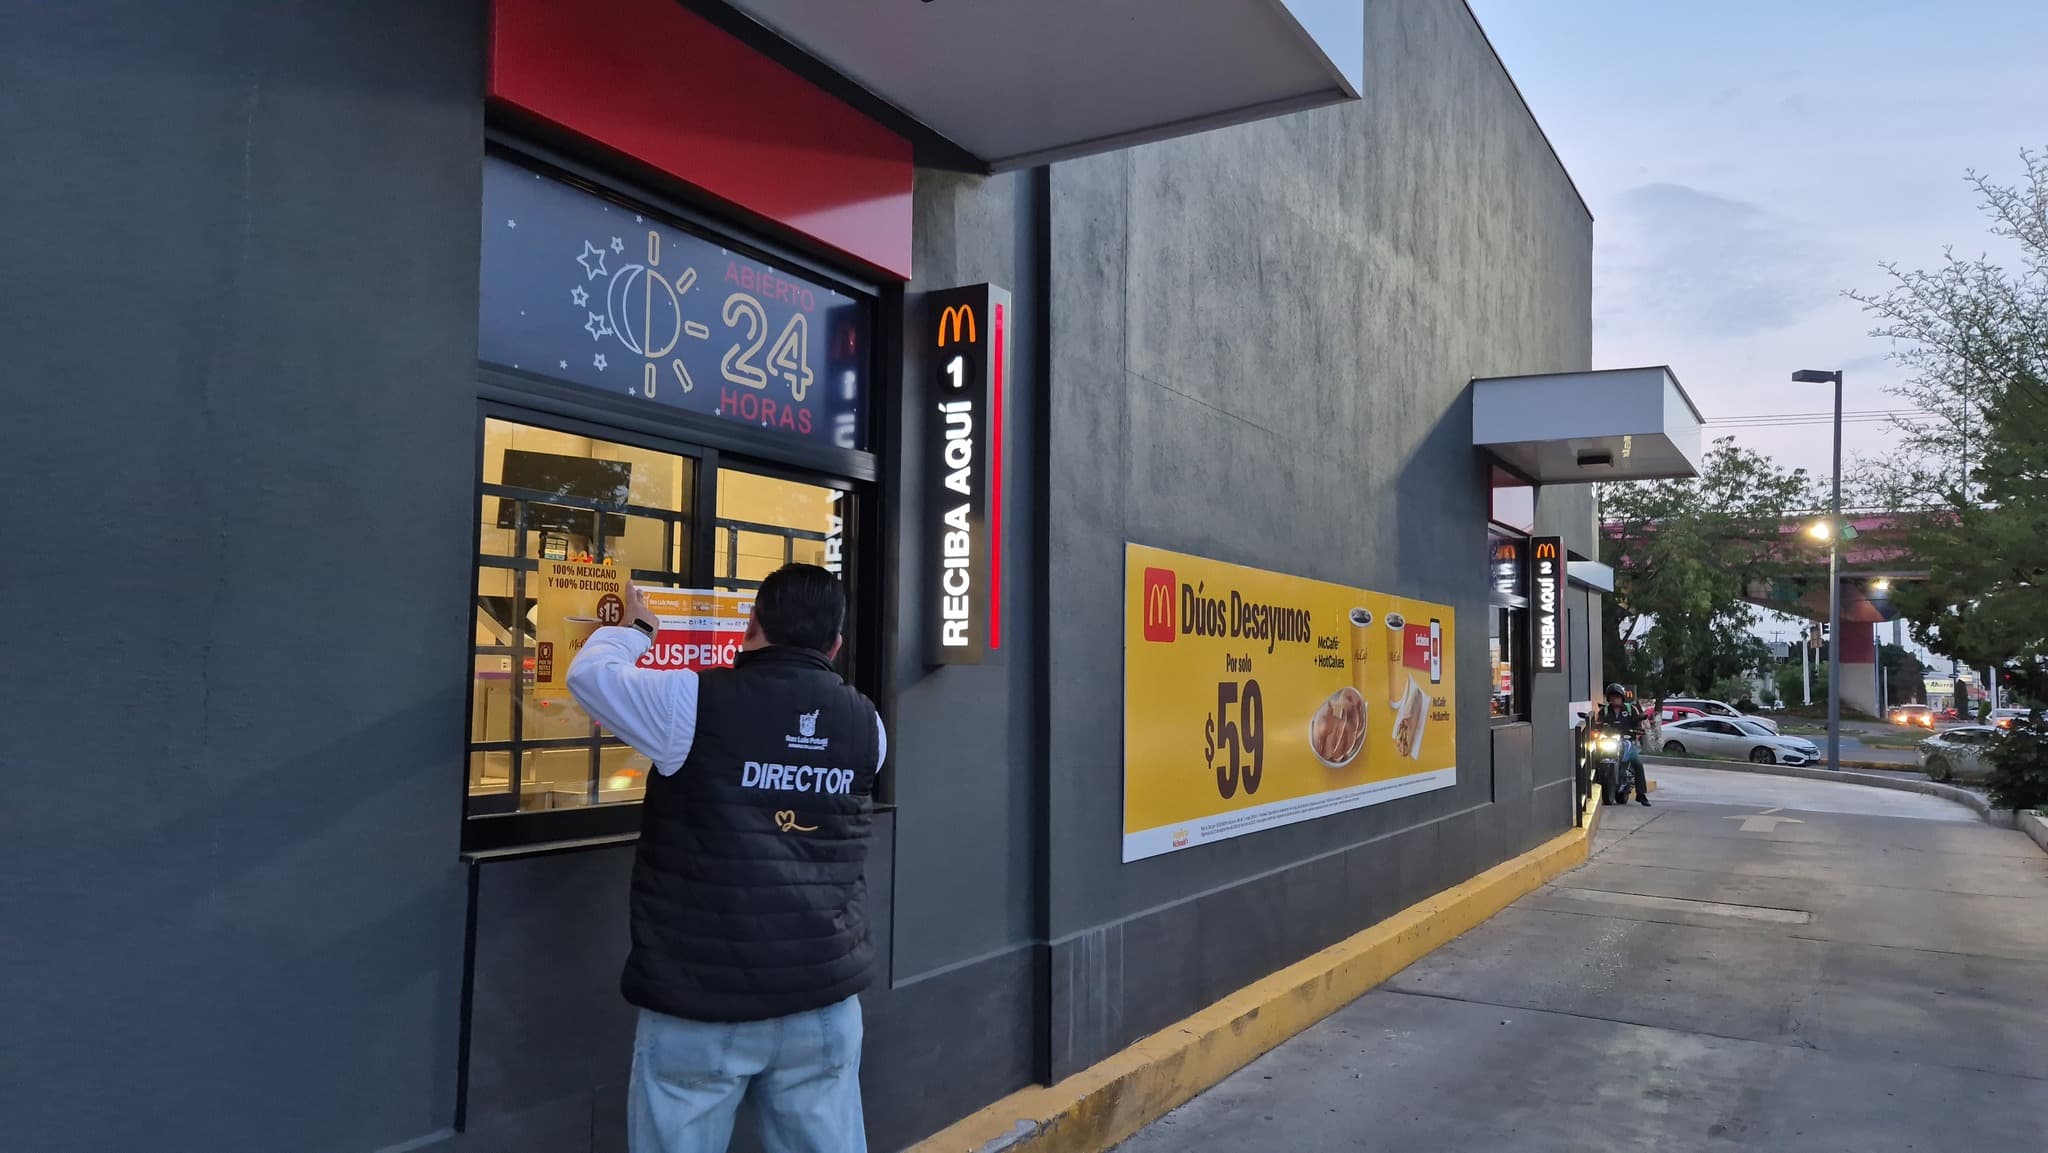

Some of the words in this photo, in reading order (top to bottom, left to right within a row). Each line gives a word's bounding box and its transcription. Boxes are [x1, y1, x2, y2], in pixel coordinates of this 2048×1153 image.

[725, 261, 815, 312] ABIERTO
[721, 293, 814, 402] 24
[947, 355, 963, 388] 1
[720, 386, 813, 435] HORAS
[938, 401, 973, 496] AQUÍ
[548, 577, 554, 588] Y
[556, 578, 577, 589] 100%
[580, 580, 619, 593] DELICIOSO
[553, 564, 575, 576] 100%
[577, 566, 617, 580] MEXICANO
[943, 503, 970, 646] RECIBA
[600, 602, 620, 623] $15
[1537, 578, 1555, 614] AQUÍ
[1182, 581, 1226, 638] Dúos
[1231, 590, 1311, 654] Desayunos
[1318, 655, 1344, 669] HotCakes
[1541, 614, 1555, 668] RECIBA
[1226, 653, 1237, 673] Por
[1238, 653, 1252, 673] solo
[1204, 679, 1264, 800] $59
[741, 761, 854, 794] DIRECTOR
